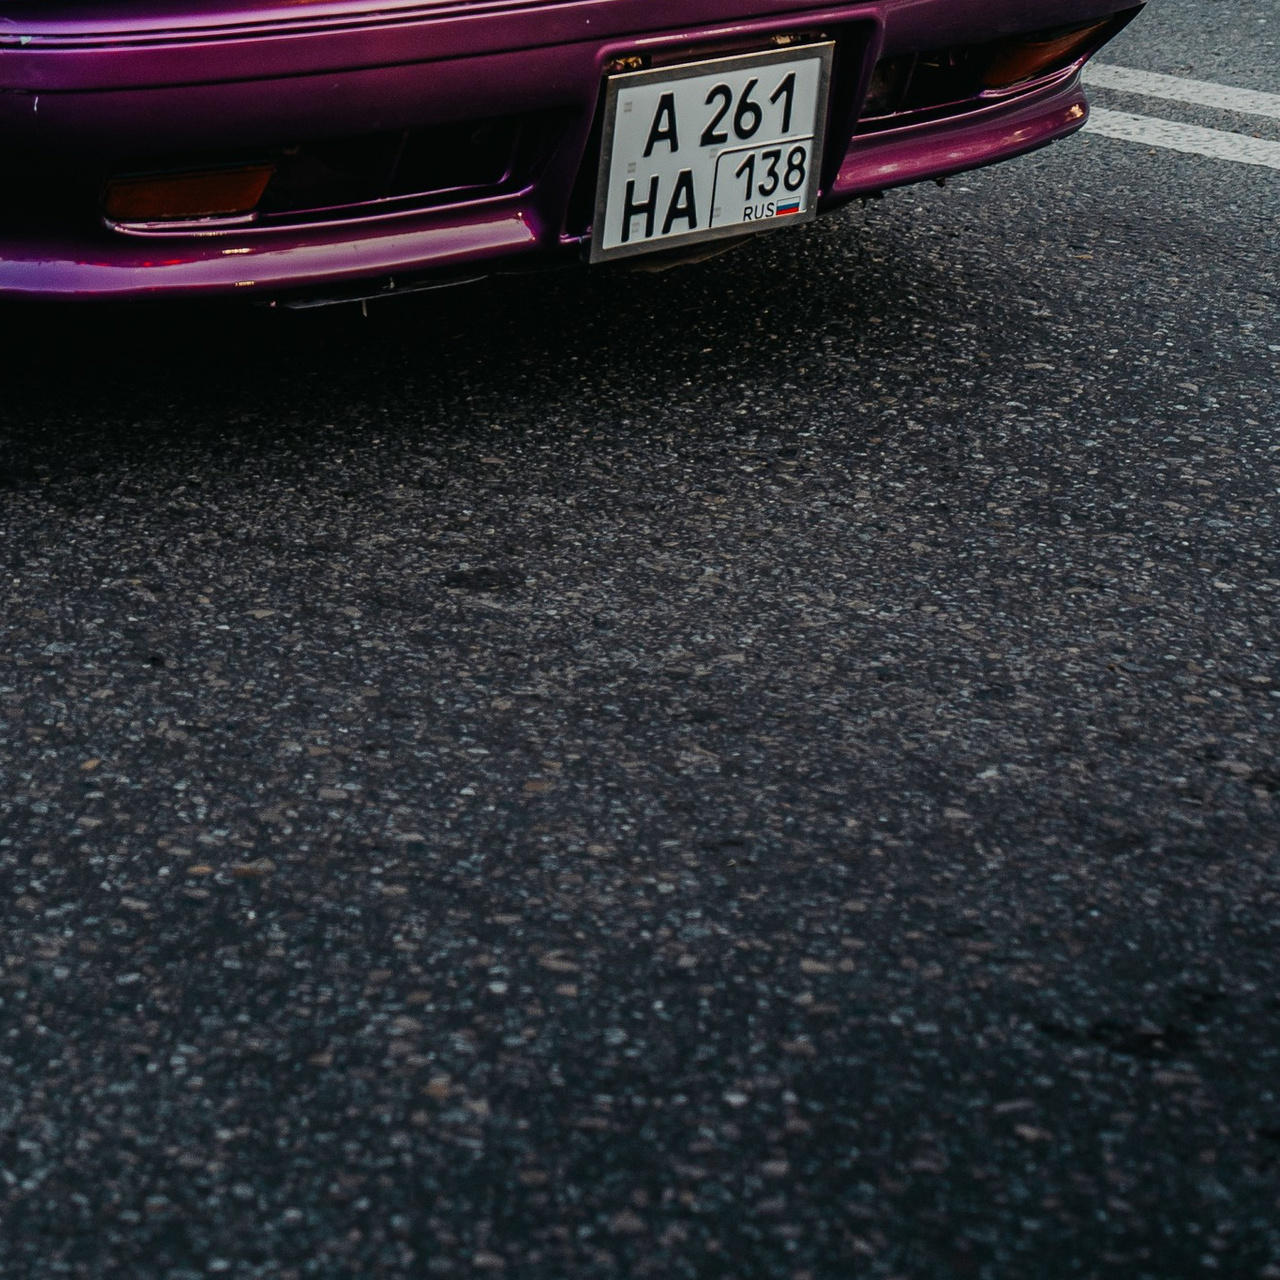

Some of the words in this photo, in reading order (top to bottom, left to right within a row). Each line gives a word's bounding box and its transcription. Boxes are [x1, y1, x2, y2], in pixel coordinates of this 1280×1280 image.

[699, 70, 796, 147] 261
[735, 145, 807, 201] 138
[743, 202, 775, 221] RUS
